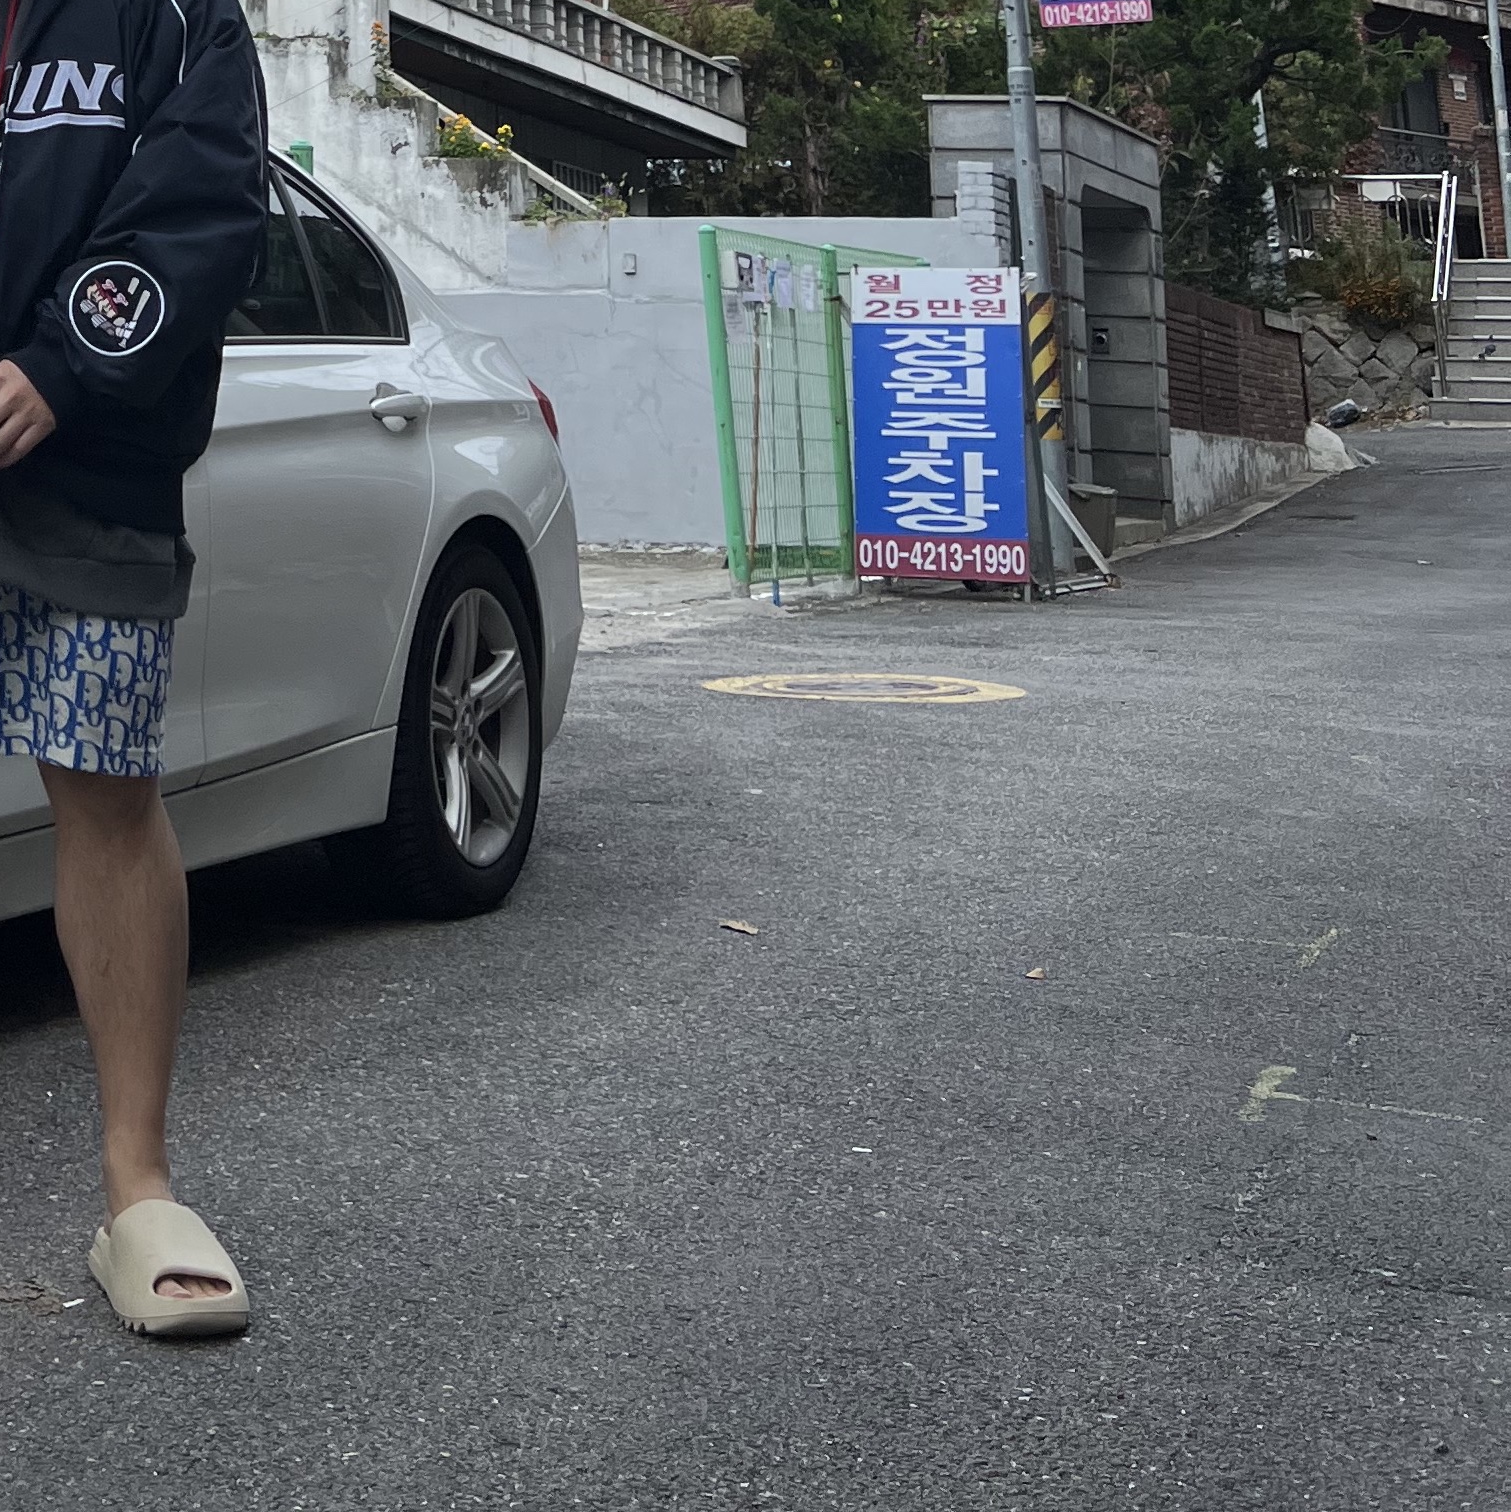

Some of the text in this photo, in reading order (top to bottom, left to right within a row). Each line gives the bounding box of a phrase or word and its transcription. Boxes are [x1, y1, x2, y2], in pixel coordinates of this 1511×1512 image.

[1044, 0, 1148, 26] 010-4213-1990
[864, 299, 1007, 319] 25만원
[878, 328, 1001, 533] 정원주차장
[859, 538, 1026, 576] 010-4213-1990
